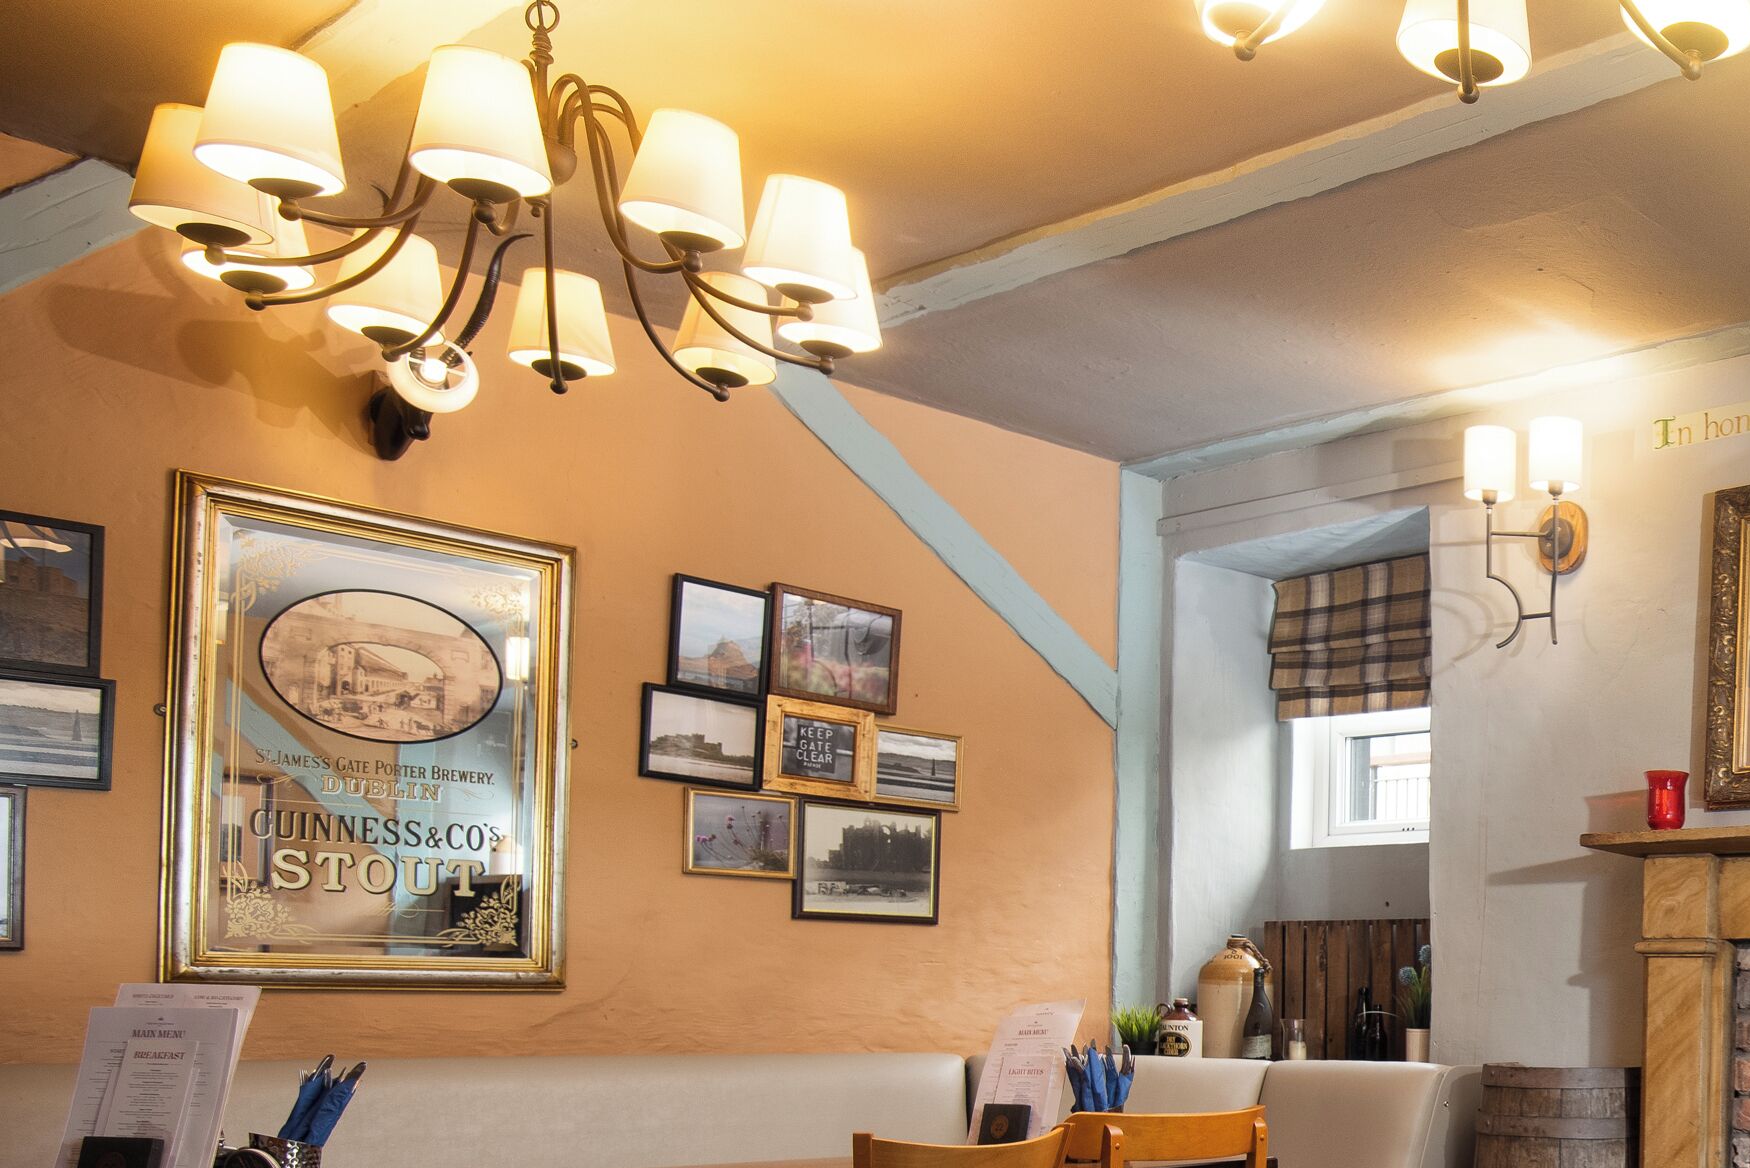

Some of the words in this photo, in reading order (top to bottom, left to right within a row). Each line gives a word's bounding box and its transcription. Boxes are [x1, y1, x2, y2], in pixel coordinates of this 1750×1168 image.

[1653, 415, 1692, 450] In
[800, 726, 833, 739] KEEP
[800, 739, 832, 753] GATE
[796, 749, 833, 764] CLEAR
[336, 756, 370, 774] GATE
[375, 760, 427, 779] PORTER
[321, 774, 445, 802] DUBLIN
[271, 848, 487, 898] STOUT
[131, 1029, 156, 1038] MAIN
[157, 1029, 187, 1039] MENU
[133, 1050, 187, 1060] BREAKFAST
